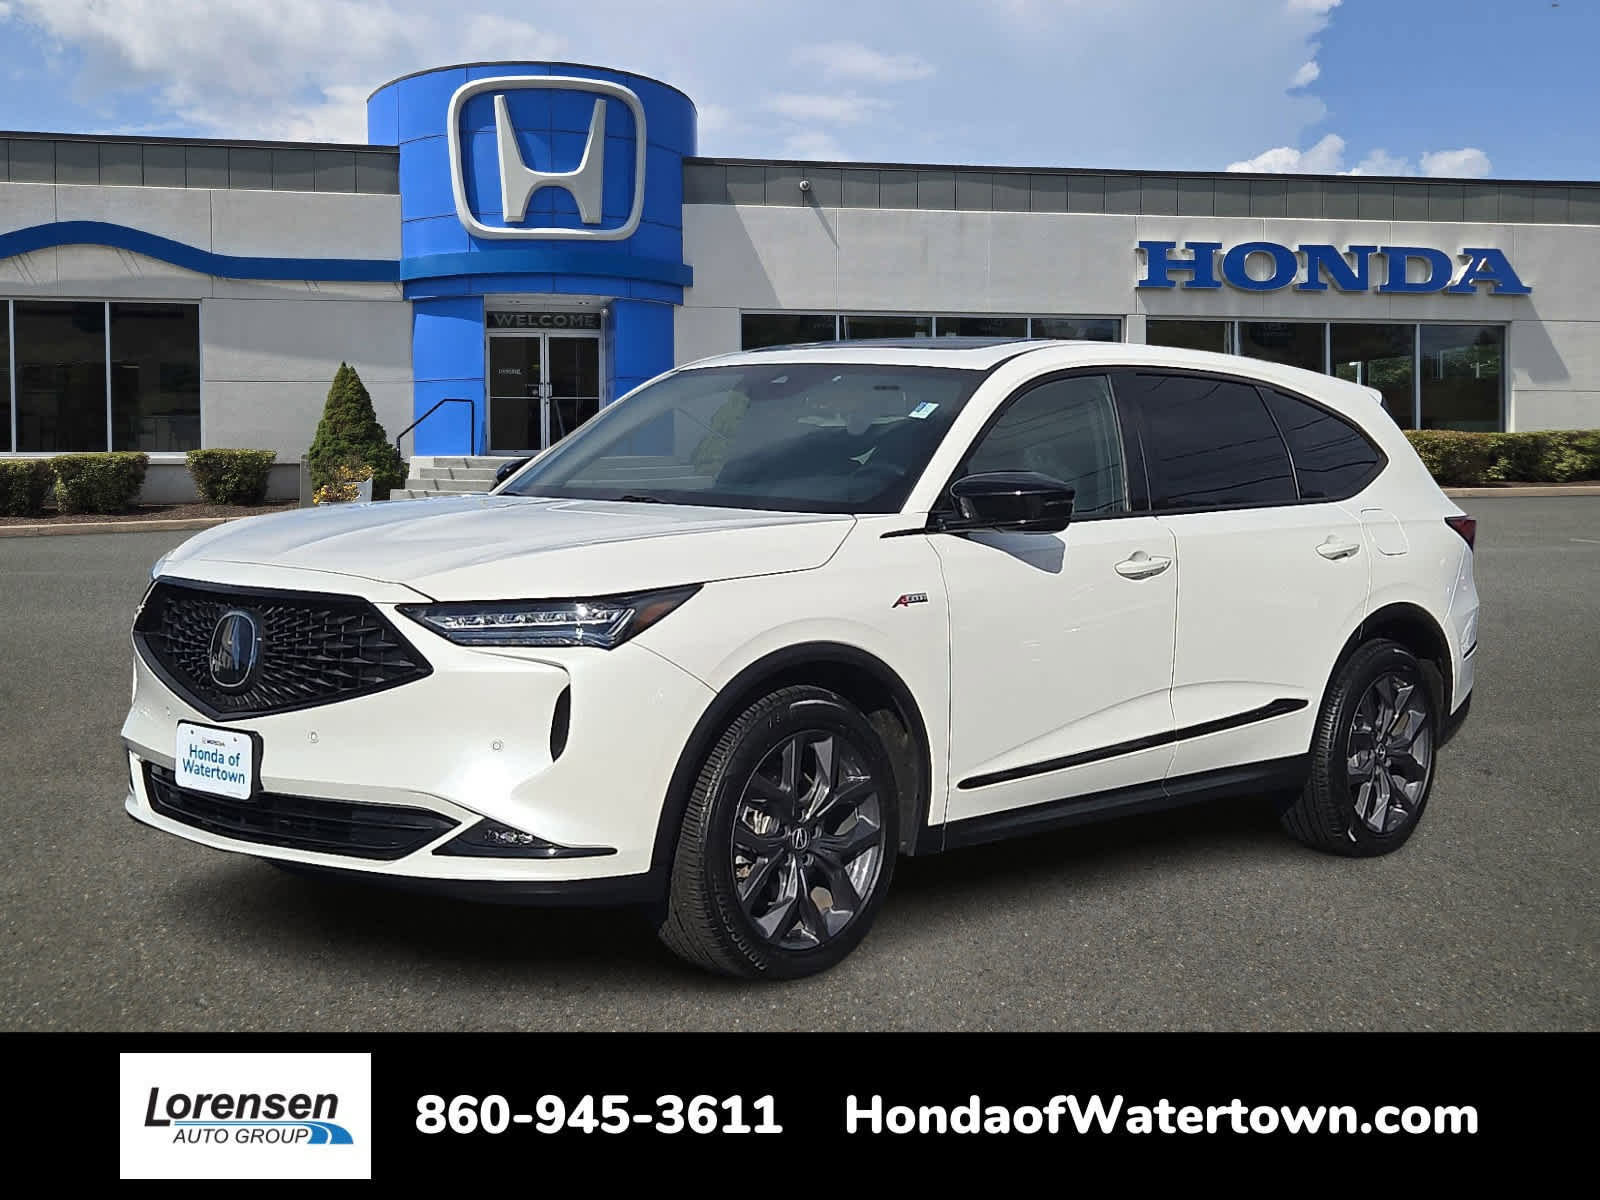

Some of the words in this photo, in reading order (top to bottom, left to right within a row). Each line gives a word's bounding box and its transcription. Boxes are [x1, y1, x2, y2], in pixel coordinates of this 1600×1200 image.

[1137, 241, 1532, 295] HONDA
[494, 313, 596, 328] WELCOME
[189, 743, 225, 765] Honda
[228, 753, 241, 767] of
[182, 758, 245, 784] Watertown
